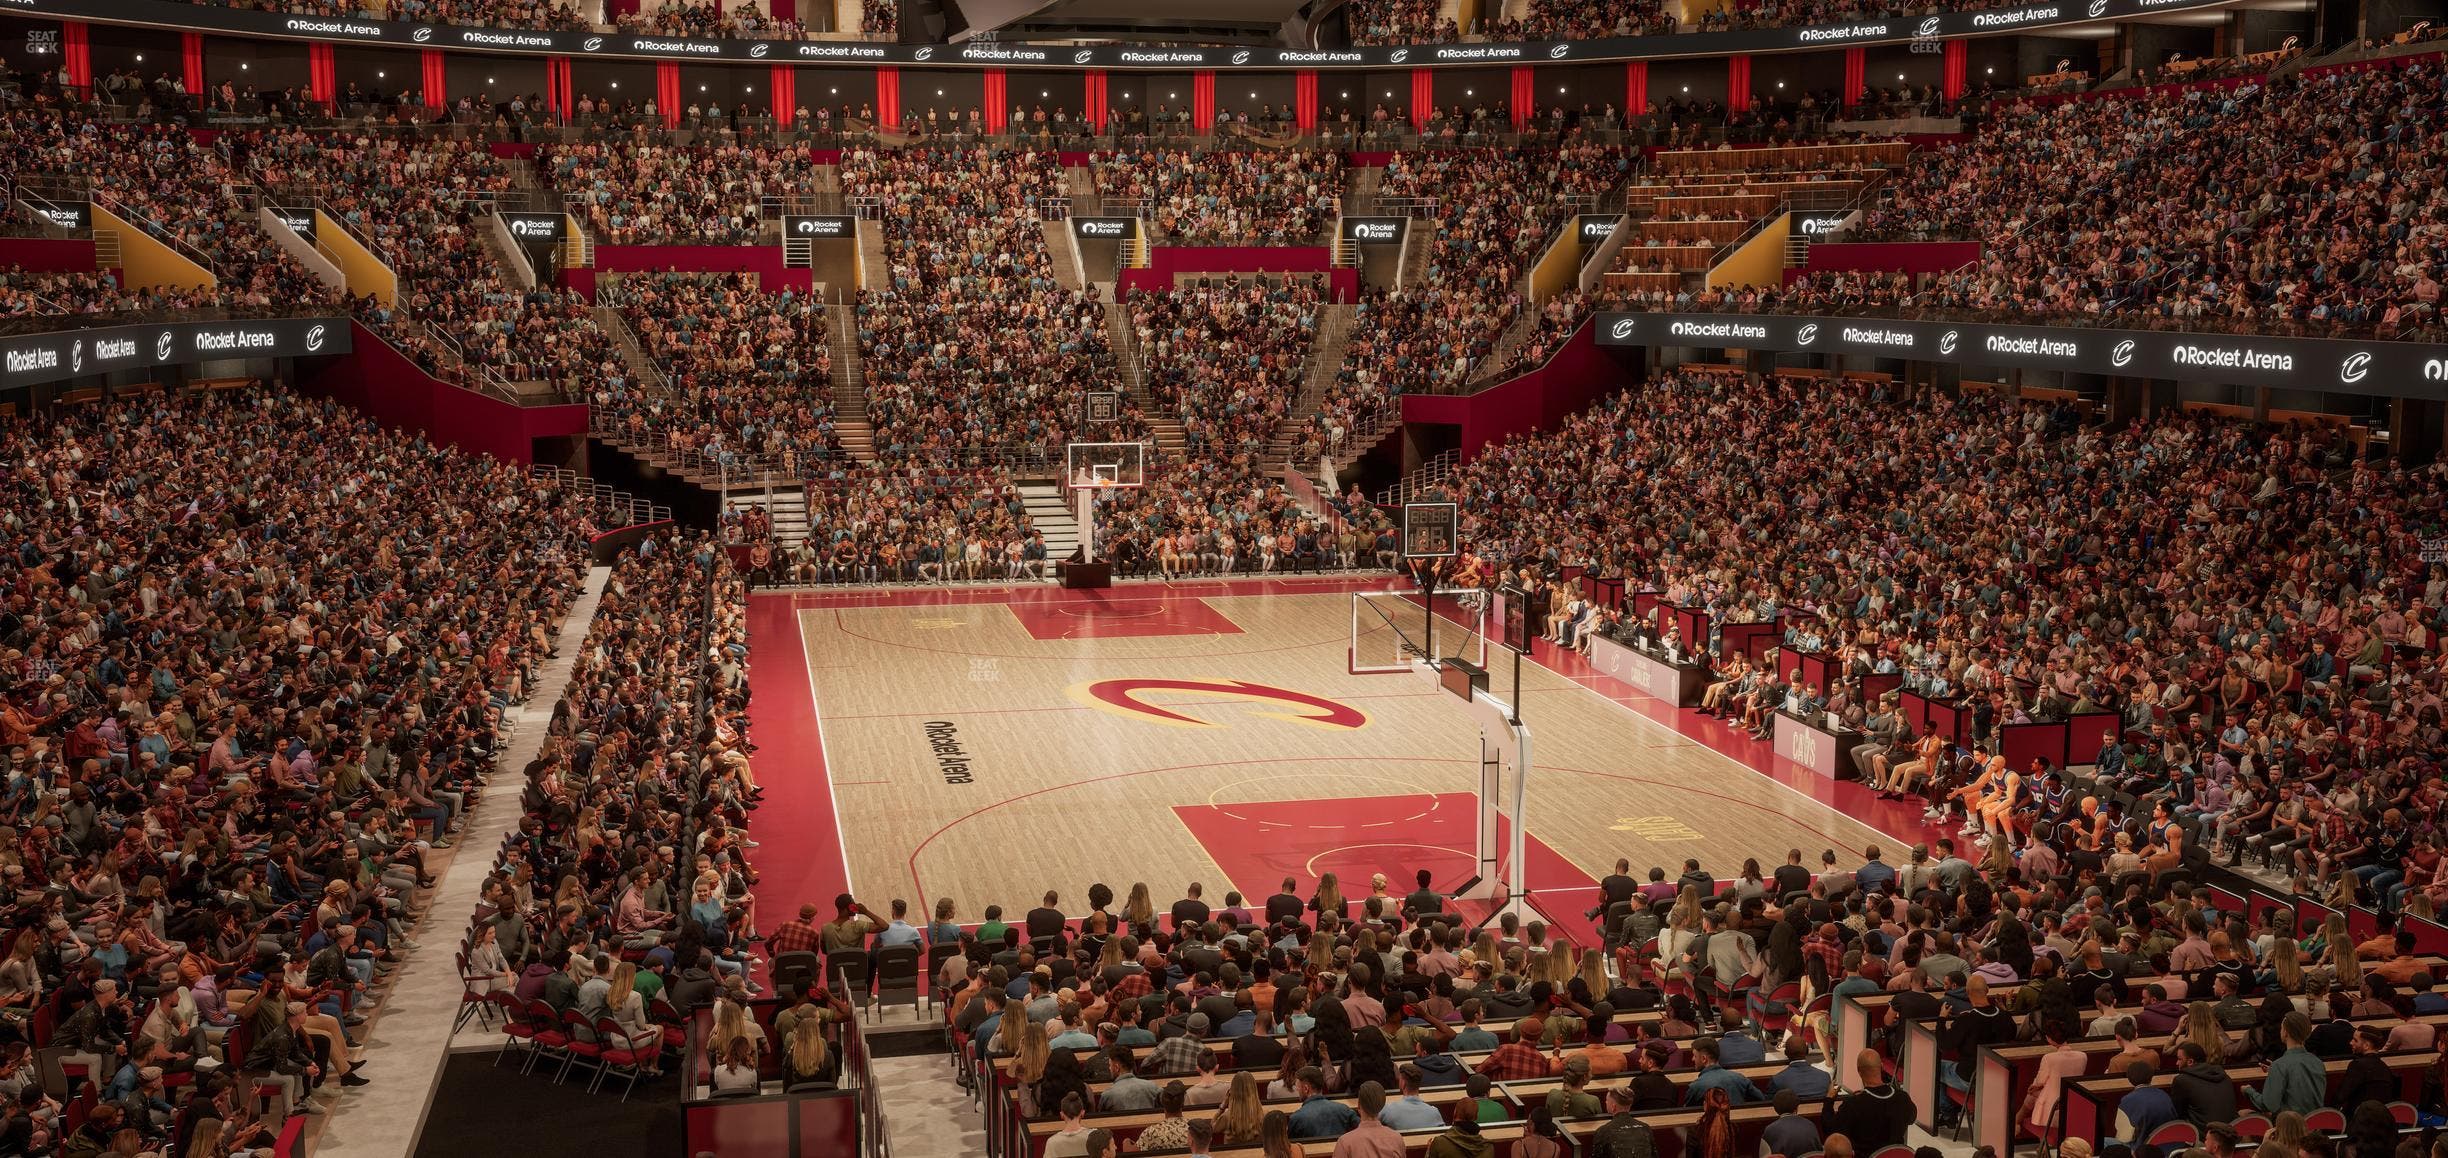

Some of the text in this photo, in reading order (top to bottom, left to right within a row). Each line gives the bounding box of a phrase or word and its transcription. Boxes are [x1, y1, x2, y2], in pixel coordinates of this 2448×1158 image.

[1986, 7, 2058, 26] Rocket Arena
[300, 20, 381, 36] Rocket Arena
[1811, 25, 1887, 41] Rocket Arena
[475, 32, 552, 46] Rocket Arena
[645, 40, 720, 53] Rocket Arena
[811, 46, 885, 57] Rocket Arena
[973, 49, 1046, 60] Rocket Arena
[1132, 52, 1203, 62] Rocket Arena
[1290, 51, 1362, 61] Rocket Arena
[1448, 48, 1521, 58] Rocket Arena
[51, 210, 79, 220] Rocket
[527, 220, 555, 228] Rocket
[1370, 223, 1396, 231] Rocket
[1370, 230, 1393, 238] Arena
[1685, 322, 1766, 338] Rocket Arena
[1852, 327, 1914, 346] Rocket Arena
[205, 330, 275, 350] Rocket Arena
[1998, 335, 2077, 357] Rocket Arena
[101, 338, 136, 360] Rocket Arena
[13, 347, 57, 372] Rocket Arena
[2188, 346, 2293, 371] Rocket Arena
[925, 728, 974, 784] Rocket Arena
[1792, 729, 1816, 768] CAVS
